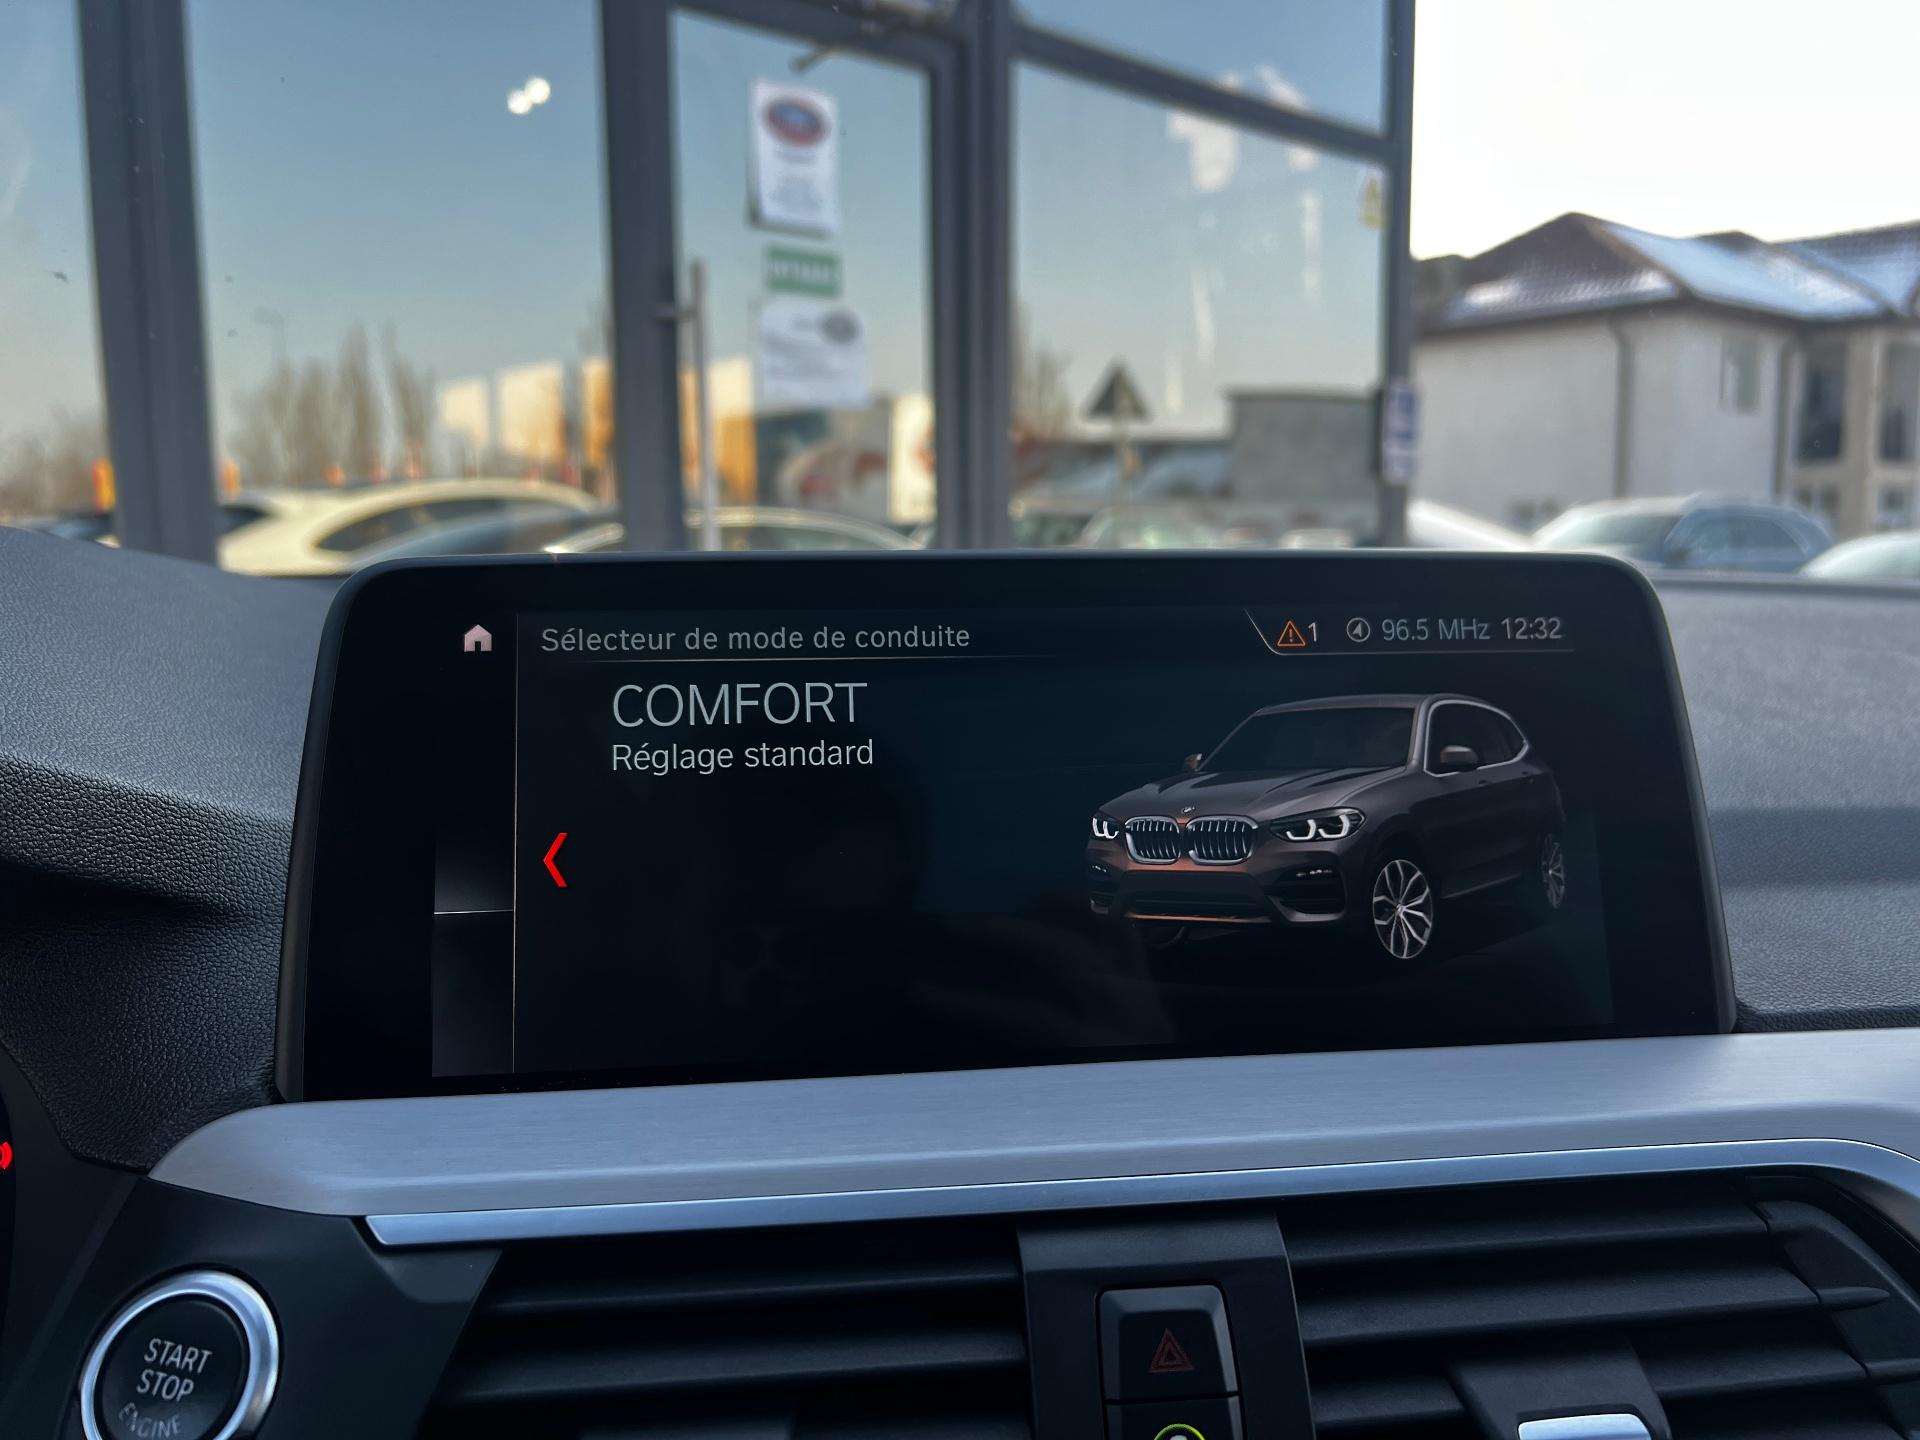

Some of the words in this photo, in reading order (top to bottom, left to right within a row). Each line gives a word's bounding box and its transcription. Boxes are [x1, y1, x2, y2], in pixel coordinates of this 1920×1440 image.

[541, 628, 677, 652] Sélecteur
[684, 628, 719, 650] de
[727, 627, 804, 649] mode
[813, 626, 848, 648] de
[855, 625, 971, 648] conduite
[1308, 622, 1319, 643] 1
[1381, 618, 1430, 641] 96.5
[1438, 618, 1491, 641] MHz
[1500, 616, 1563, 640] 12:32
[612, 682, 868, 728] COMFORT
[611, 743, 734, 776] Réglage
[744, 739, 875, 769] standard
[144, 1338, 212, 1373] START
[137, 1369, 194, 1401] STOP
